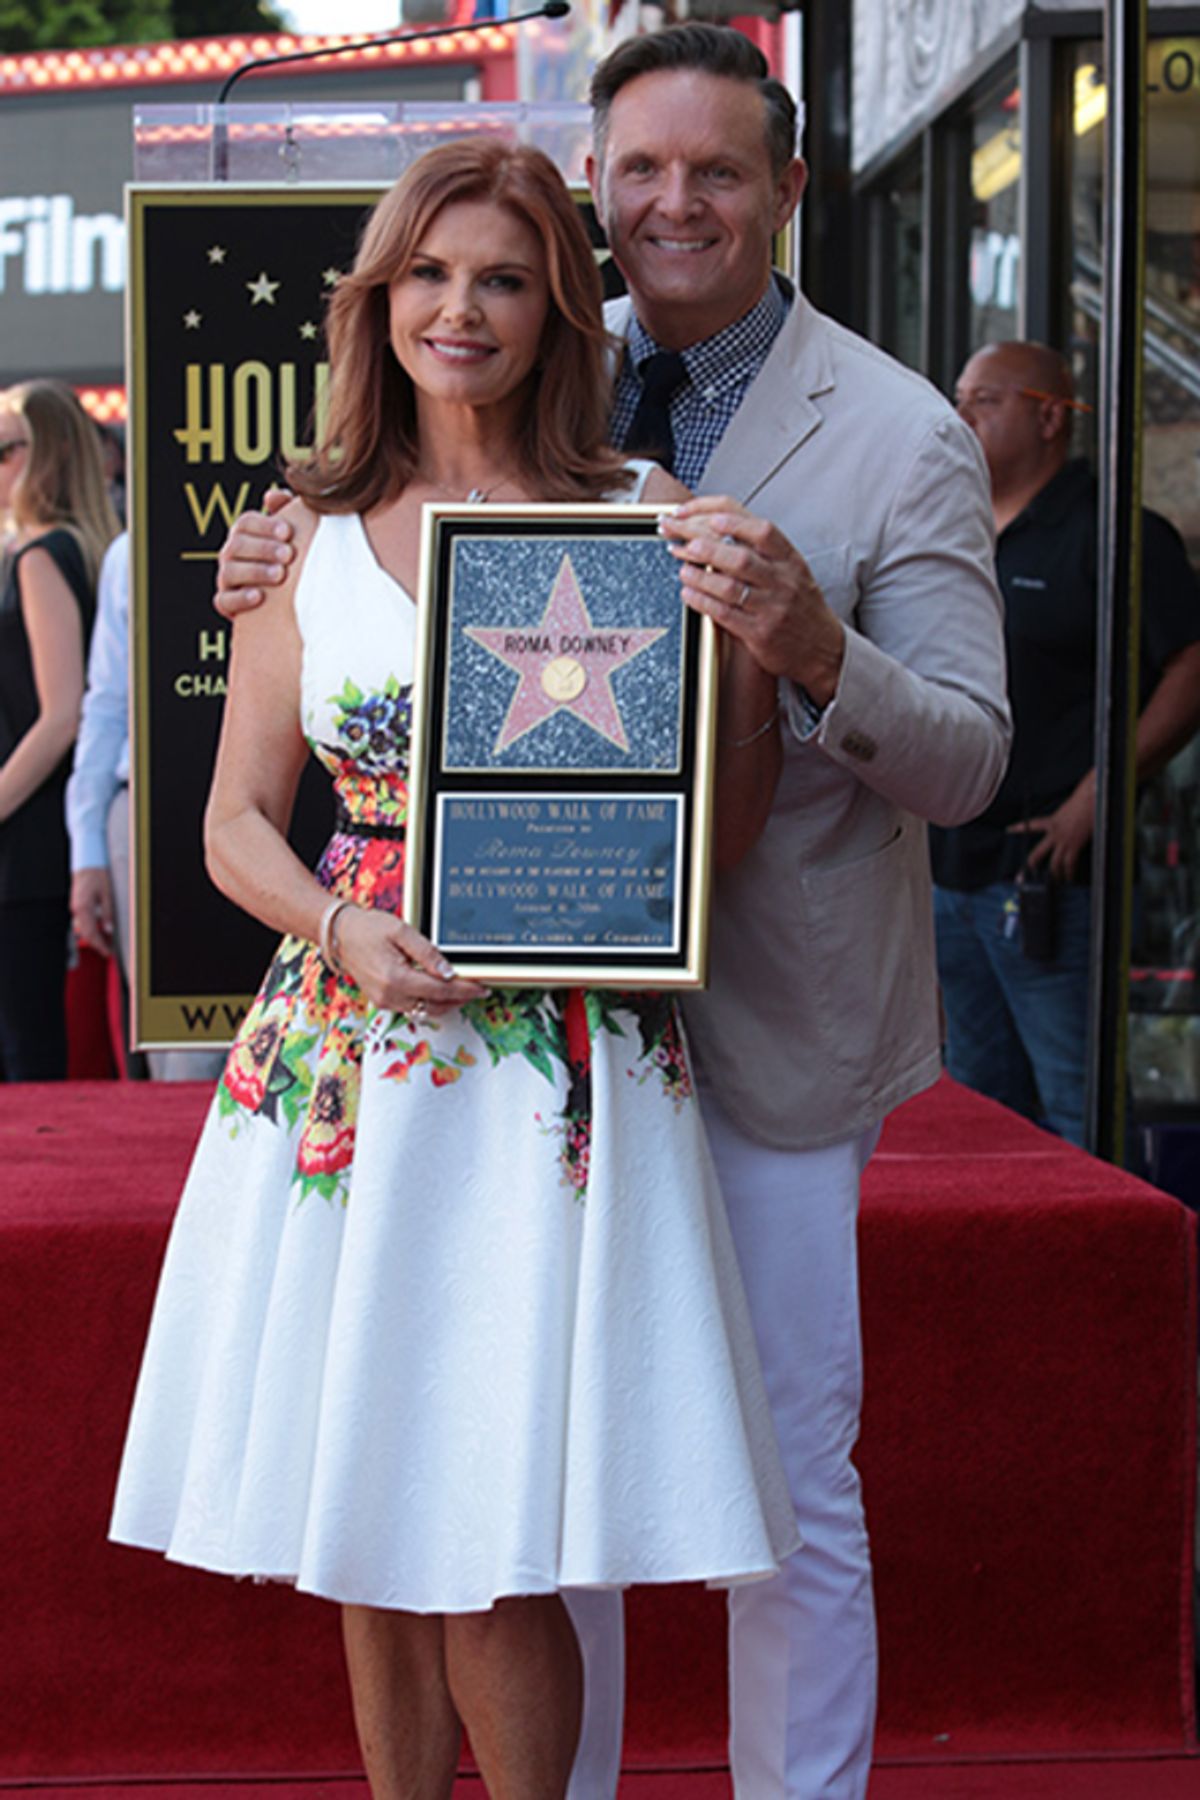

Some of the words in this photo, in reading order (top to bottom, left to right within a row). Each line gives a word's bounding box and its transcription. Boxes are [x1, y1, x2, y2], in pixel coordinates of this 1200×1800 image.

[504, 635, 552, 654] ROMA
[559, 635, 631, 654] DOWNEY
[449, 801, 541, 820] HOLLYWOOD
[548, 802, 592, 820] WALK
[599, 802, 618, 821] OF
[625, 803, 666, 821] FAME
[474, 837, 543, 860] Roma
[547, 881, 589, 898] WALK
[598, 881, 616, 898] OF
[624, 882, 666, 899] FAME
